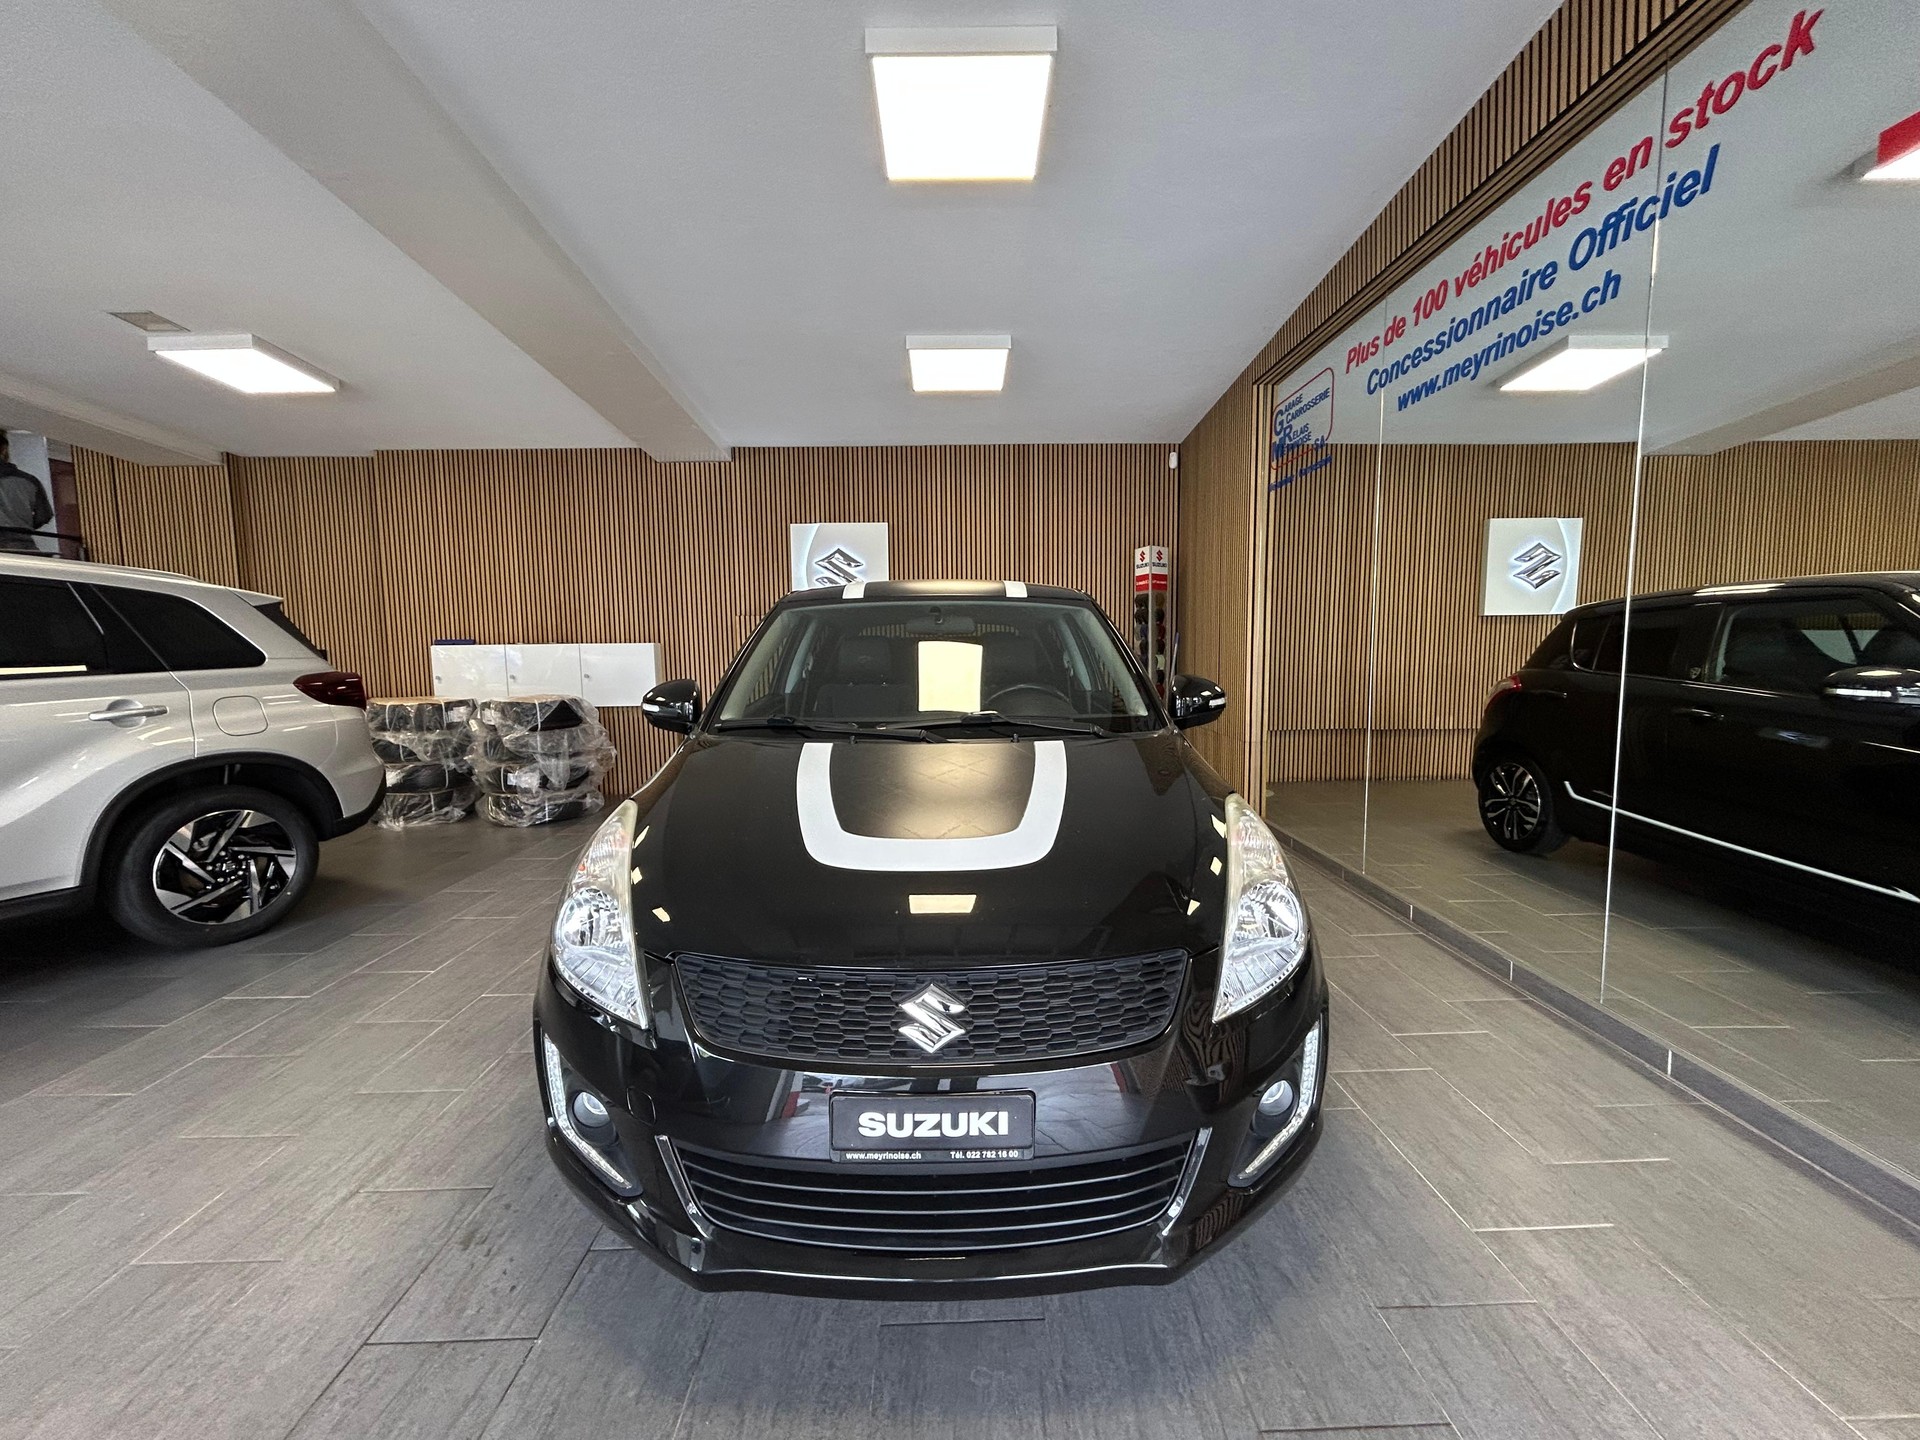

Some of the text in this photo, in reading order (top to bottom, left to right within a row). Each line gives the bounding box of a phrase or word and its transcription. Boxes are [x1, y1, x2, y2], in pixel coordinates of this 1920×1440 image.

[1346, 8, 1824, 374] Plus de 100 véhicules en stock
[1366, 143, 1721, 395] Concessionnaire Officiel
[1397, 269, 1622, 411] www.meyrinoise.ch
[846, 1151, 922, 1161] www.meyrinoise.ch
[858, 1111, 1009, 1138] SUZUKI
[966, 1151, 981, 1159] 022
